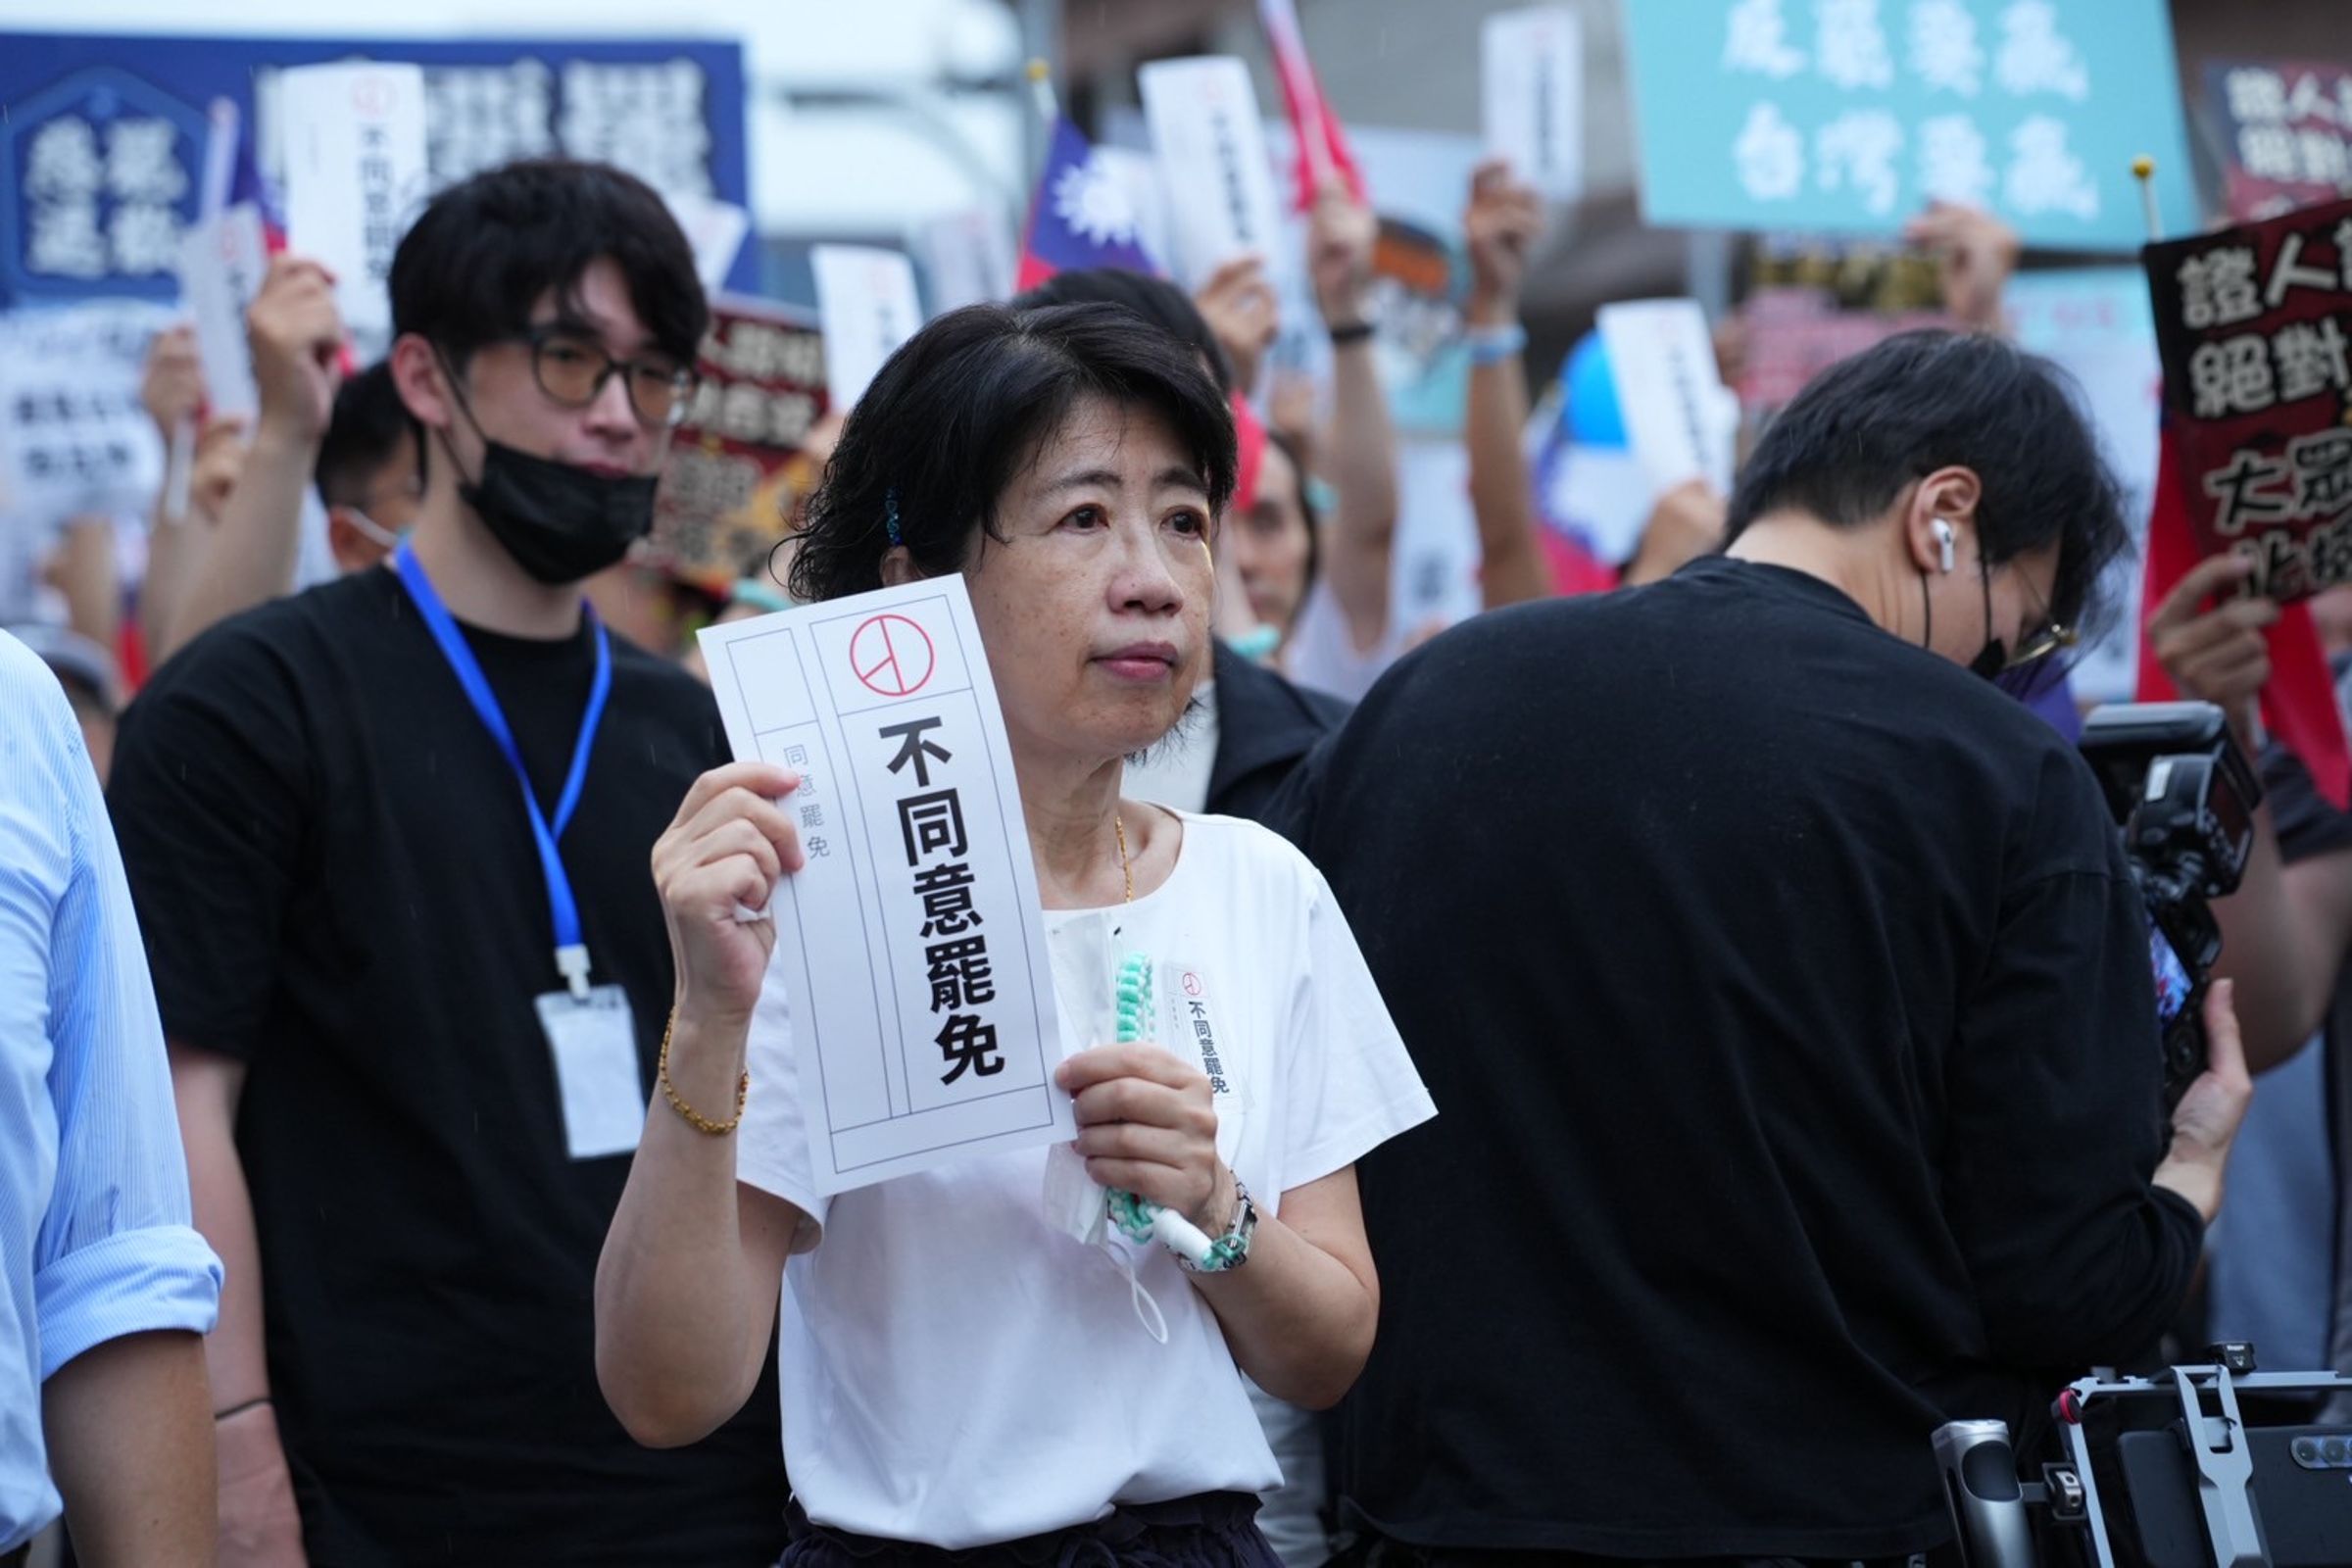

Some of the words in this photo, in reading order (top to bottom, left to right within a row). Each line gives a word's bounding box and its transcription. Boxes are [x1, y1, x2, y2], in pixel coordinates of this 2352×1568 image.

[2176, 218, 2352, 328] 證人
[2189, 316, 2350, 418] 絕對
[878, 714, 1005, 1086] 不同意罷免
[1188, 1000, 1230, 1094] 不同意罷免
